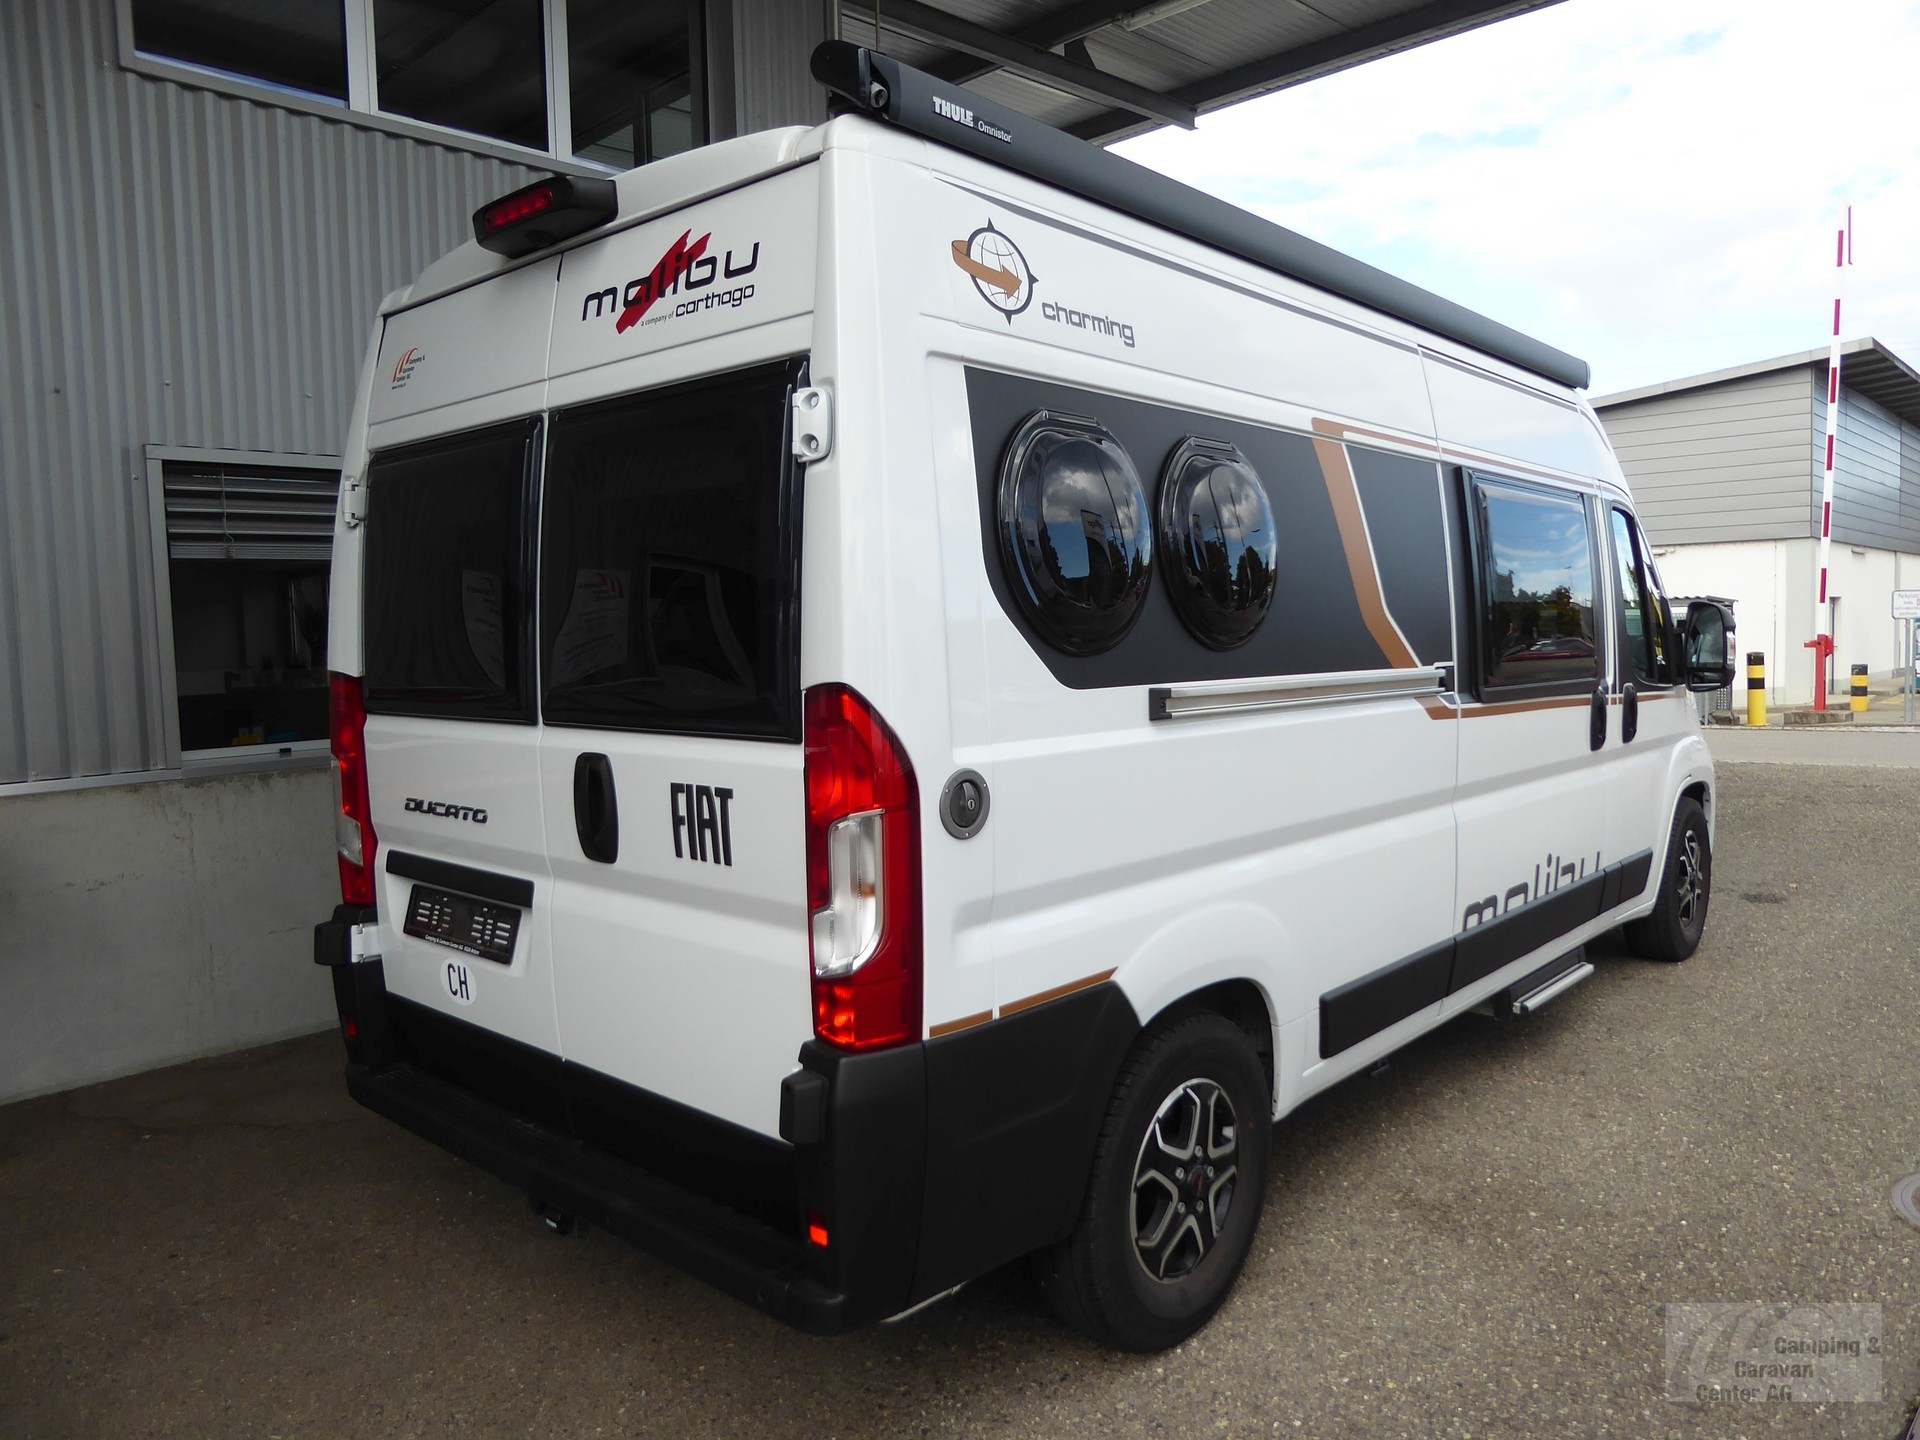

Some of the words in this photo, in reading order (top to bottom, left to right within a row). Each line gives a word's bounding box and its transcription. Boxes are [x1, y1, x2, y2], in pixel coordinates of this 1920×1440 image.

[932, 96, 974, 128] THULE
[978, 120, 1012, 144] Omnistor
[581, 241, 760, 322] malibu
[645, 314, 668, 326] company
[668, 310, 675, 321] of
[675, 284, 755, 317] carthago
[1041, 301, 1136, 348] charming
[405, 797, 489, 824] DUCATO
[670, 782, 734, 867] FIAT
[447, 963, 470, 1001] CH
